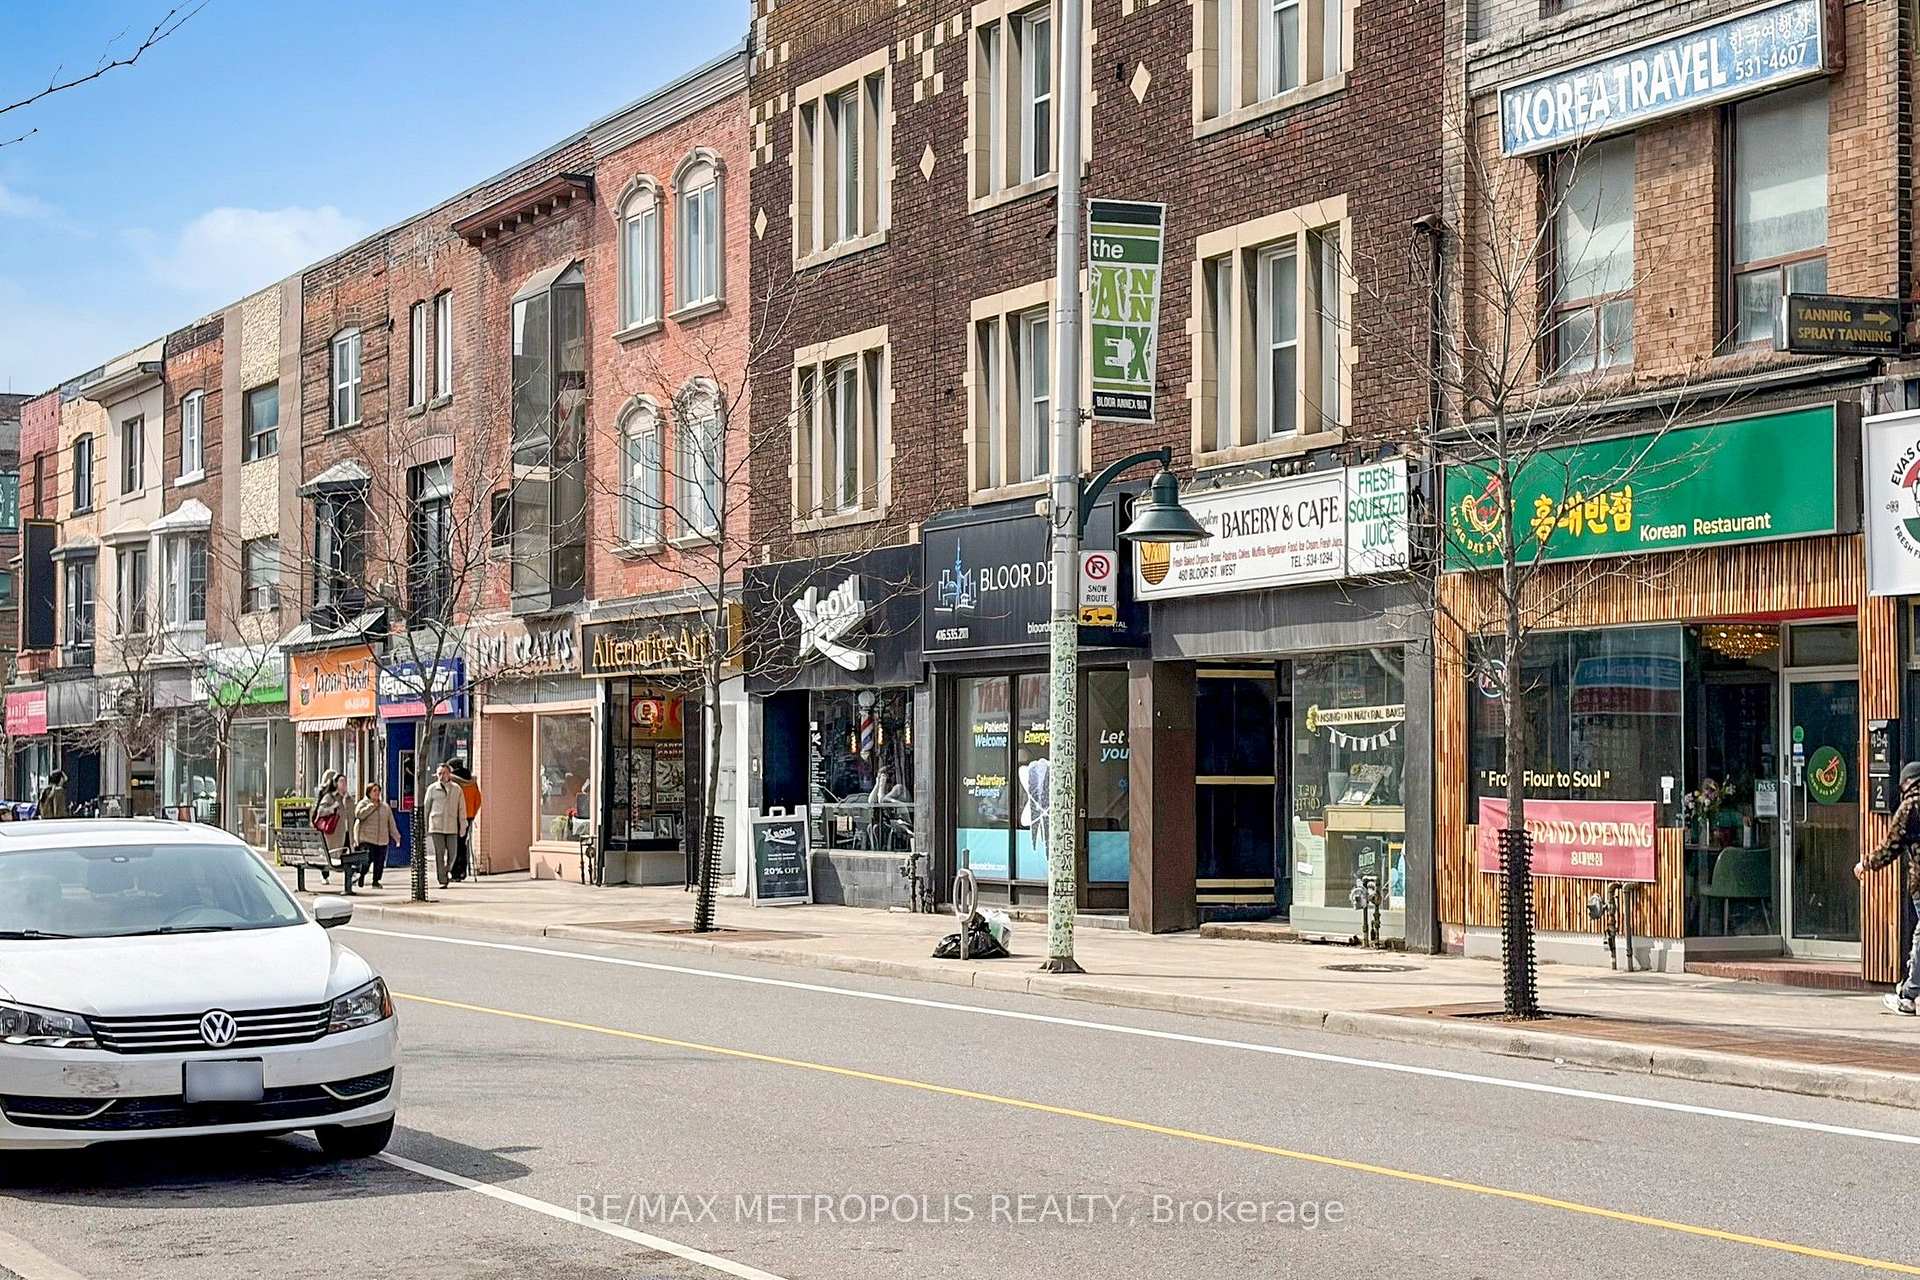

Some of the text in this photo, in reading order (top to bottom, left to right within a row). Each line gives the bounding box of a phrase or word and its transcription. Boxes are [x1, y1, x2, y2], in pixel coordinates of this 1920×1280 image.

[1735, 43, 1807, 81] 531-4607
[1514, 37, 1727, 142] KOREA TRAVEL
[1092, 239, 1124, 260] the
[1798, 308, 1852, 322] TANNING
[1798, 327, 1892, 342] SPRAY TANNING
[1096, 396, 1117, 408] BLOOR
[1117, 398, 1135, 409] ANNEX
[1358, 466, 1395, 494] FRESH
[1348, 492, 1406, 523] SQUEEZED
[1221, 505, 1280, 539] BAKERY
[1282, 504, 1293, 531] &
[1640, 512, 1772, 542] Korean Restaurant
[1361, 520, 1395, 549] JUICE
[1894, 525, 1914, 555] FRESH
[980, 564, 1031, 592] BLOOR
[1189, 567, 1209, 581] BLOOR
[1086, 594, 1108, 603] ROUTE
[1087, 585, 1107, 593] SNOW
[313, 666, 341, 698] Japan
[1063, 658, 1074, 757] BLOOR
[984, 721, 1009, 733] Patients
[1100, 729, 1125, 744] Let
[975, 734, 1007, 747] Welcome
[976, 774, 1007, 787] Saturdays
[1523, 769, 1554, 787] Flour
[1557, 771, 1570, 787] to
[974, 786, 1000, 798] Evenings
[1876, 785, 1884, 800] 2
[1062, 772, 1074, 872] ANNEX
[1579, 820, 1653, 848] OPENING
[763, 866, 801, 876] 20% OFF
